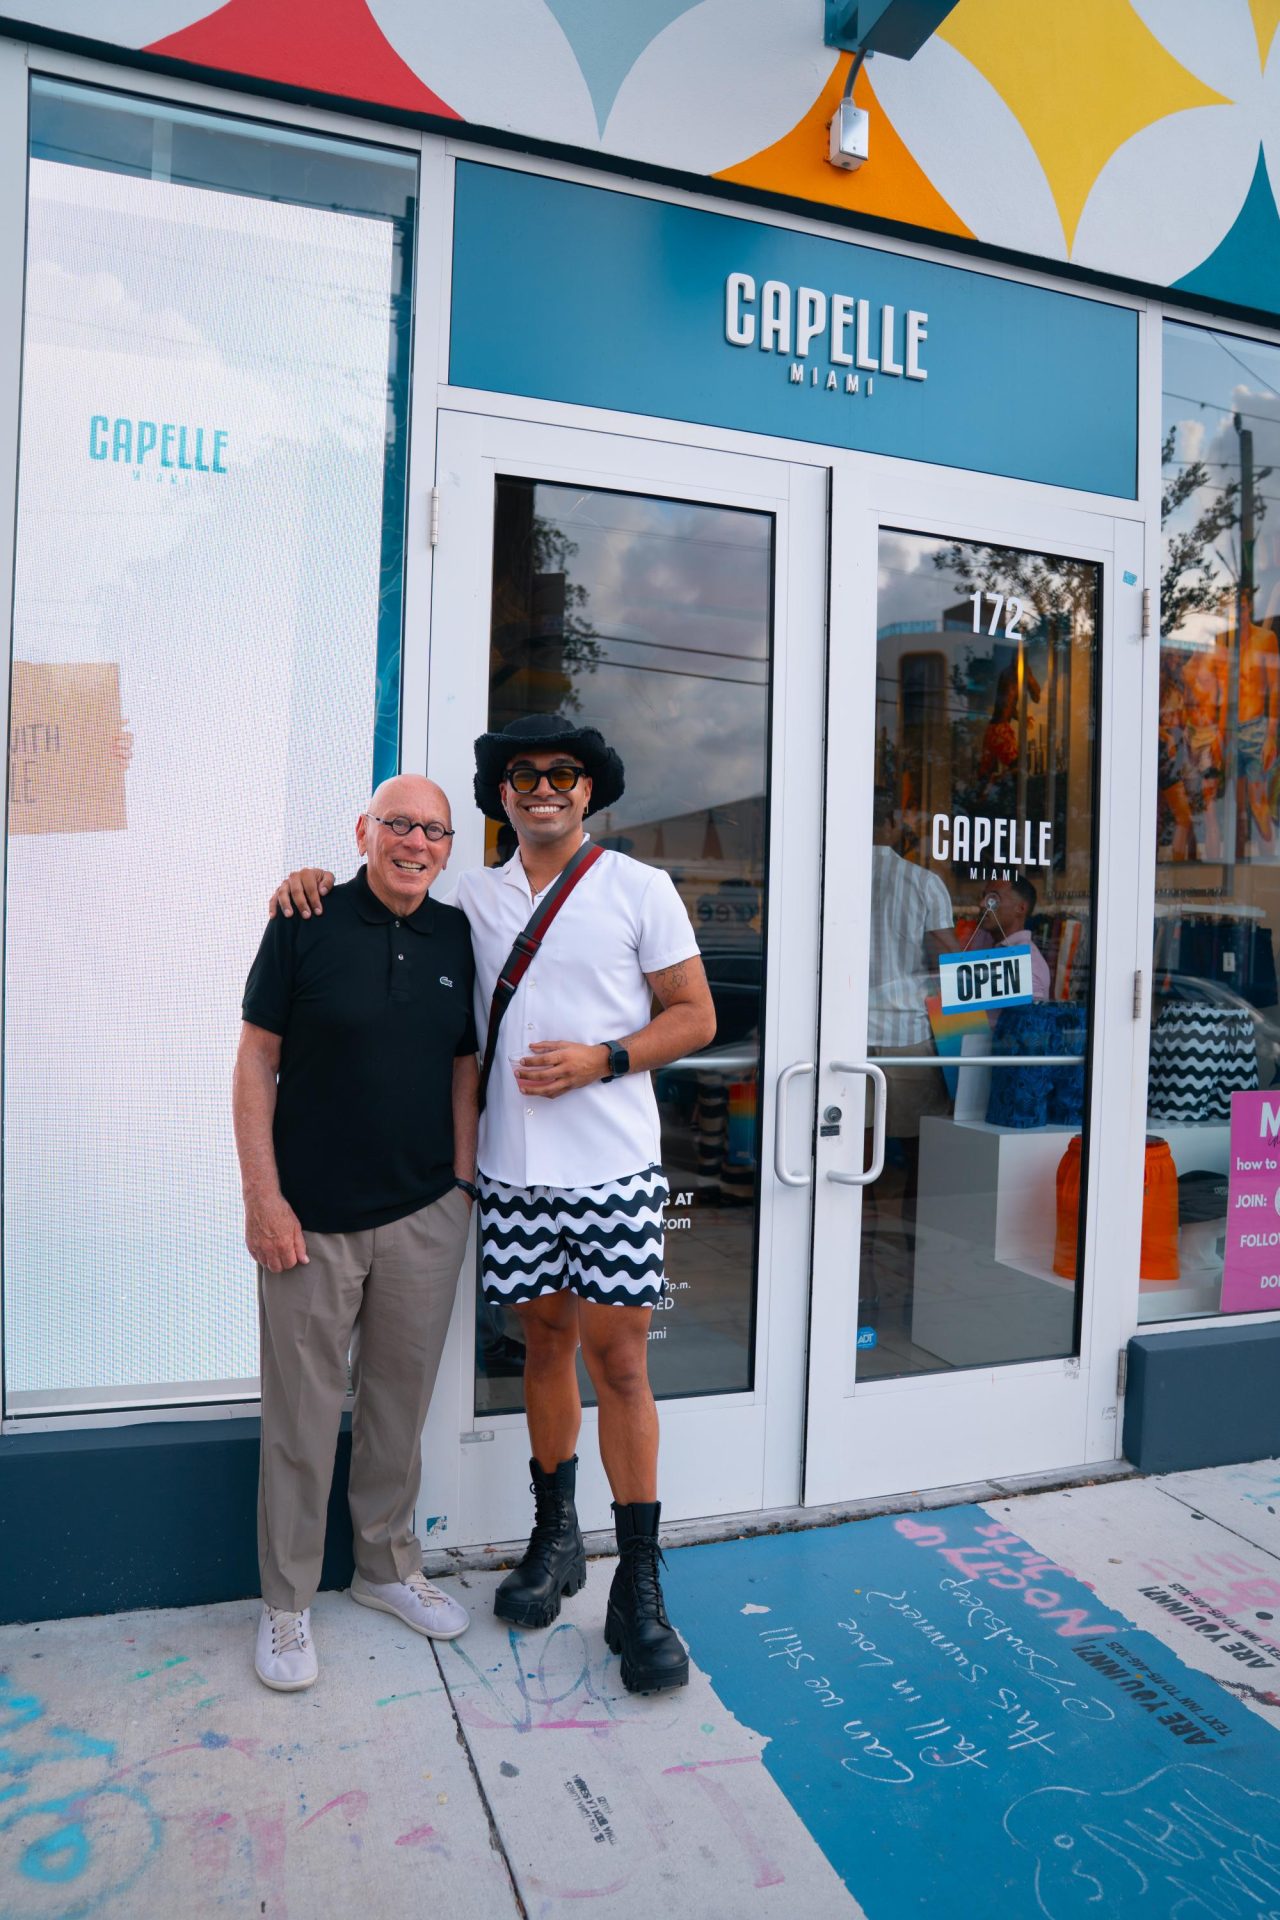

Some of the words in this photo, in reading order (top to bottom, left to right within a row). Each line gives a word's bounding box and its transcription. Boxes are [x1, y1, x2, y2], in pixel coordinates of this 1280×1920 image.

[725, 272, 928, 382] CAPELLE
[789, 362, 873, 397] MIAMI
[89, 415, 229, 474] CAPELLE
[132, 469, 191, 487] MAMI
[970, 590, 1024, 641] 172
[932, 813, 1053, 867] CAPELLE
[969, 867, 1020, 882] MIAMI
[956, 958, 1021, 1002] OPEN
[1236, 1157, 1263, 1171] how
[1265, 1158, 1278, 1170] to
[675, 1192, 694, 1206] AT
[1235, 1194, 1267, 1209] JOIN:
[1240, 1232, 1280, 1248] FOLLO
[652, 1297, 675, 1311] ED
[857, 1332, 875, 1344] ADT
[1180, 1615, 1231, 1643] YOU
[1219, 1641, 1276, 1669] ARE
[804, 1676, 845, 1707] we
[889, 1679, 922, 1703] in
[1119, 1679, 1169, 1713] YOU
[987, 1688, 1056, 1755] this
[1156, 1711, 1218, 1745] ARE
[1199, 1714, 1233, 1737] TEXT
[841, 1720, 915, 1784] Can
[905, 1718, 989, 1769] fall
